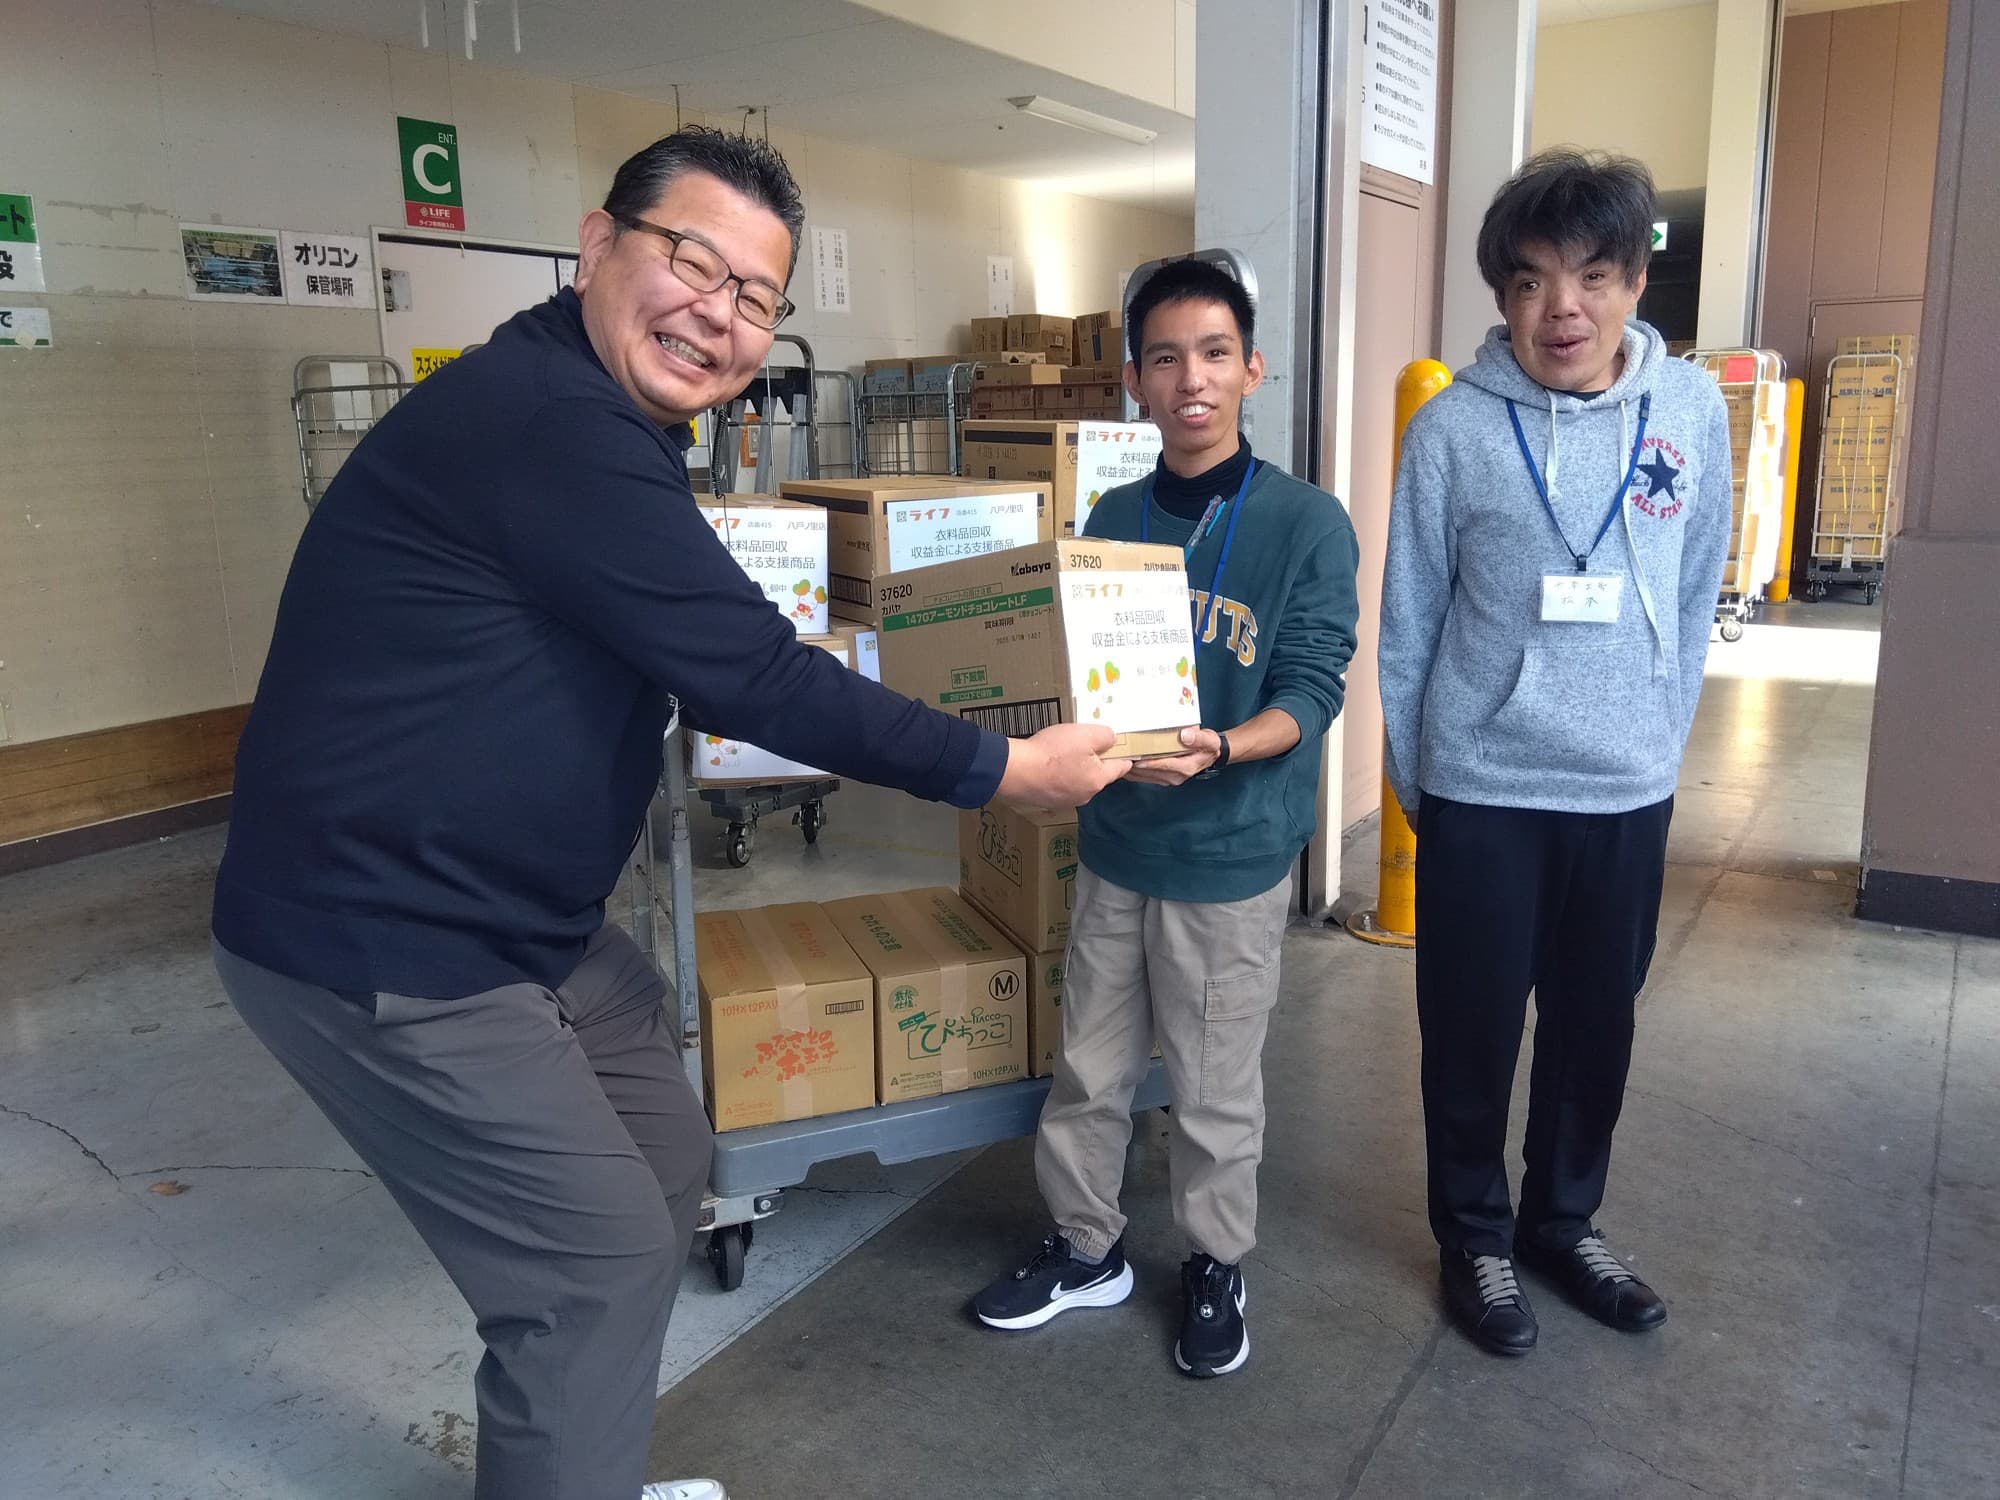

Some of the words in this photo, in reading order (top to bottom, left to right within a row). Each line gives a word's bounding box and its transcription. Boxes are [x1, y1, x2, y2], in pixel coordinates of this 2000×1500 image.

[438, 132, 456, 144] ENT.
[413, 143, 452, 194] C
[429, 207, 450, 218] LIFE
[294, 243, 359, 268] オリコン
[306, 275, 354, 297] 保管場所
[1098, 431, 1136, 443] ライフ
[909, 507, 951, 521] ライフ
[1630, 493, 1656, 517] ALL
[1660, 499, 1683, 519] STAR
[786, 521, 826, 531] 八戸ノ里店
[935, 525, 991, 542] 衣料品回収
[911, 538, 1015, 560] 収益金による支援商品
[1010, 561, 1052, 577] Kabaya
[1070, 553, 1103, 570] 37620
[880, 583, 914, 602] 37620
[1084, 583, 1124, 599] ライフ
[984, 616, 1014, 630] 賞味期限
[1114, 610, 1166, 626] 衣料品回収
[1091, 628, 1189, 649] 収益金による支援商品
[995, 974, 1014, 997] M
